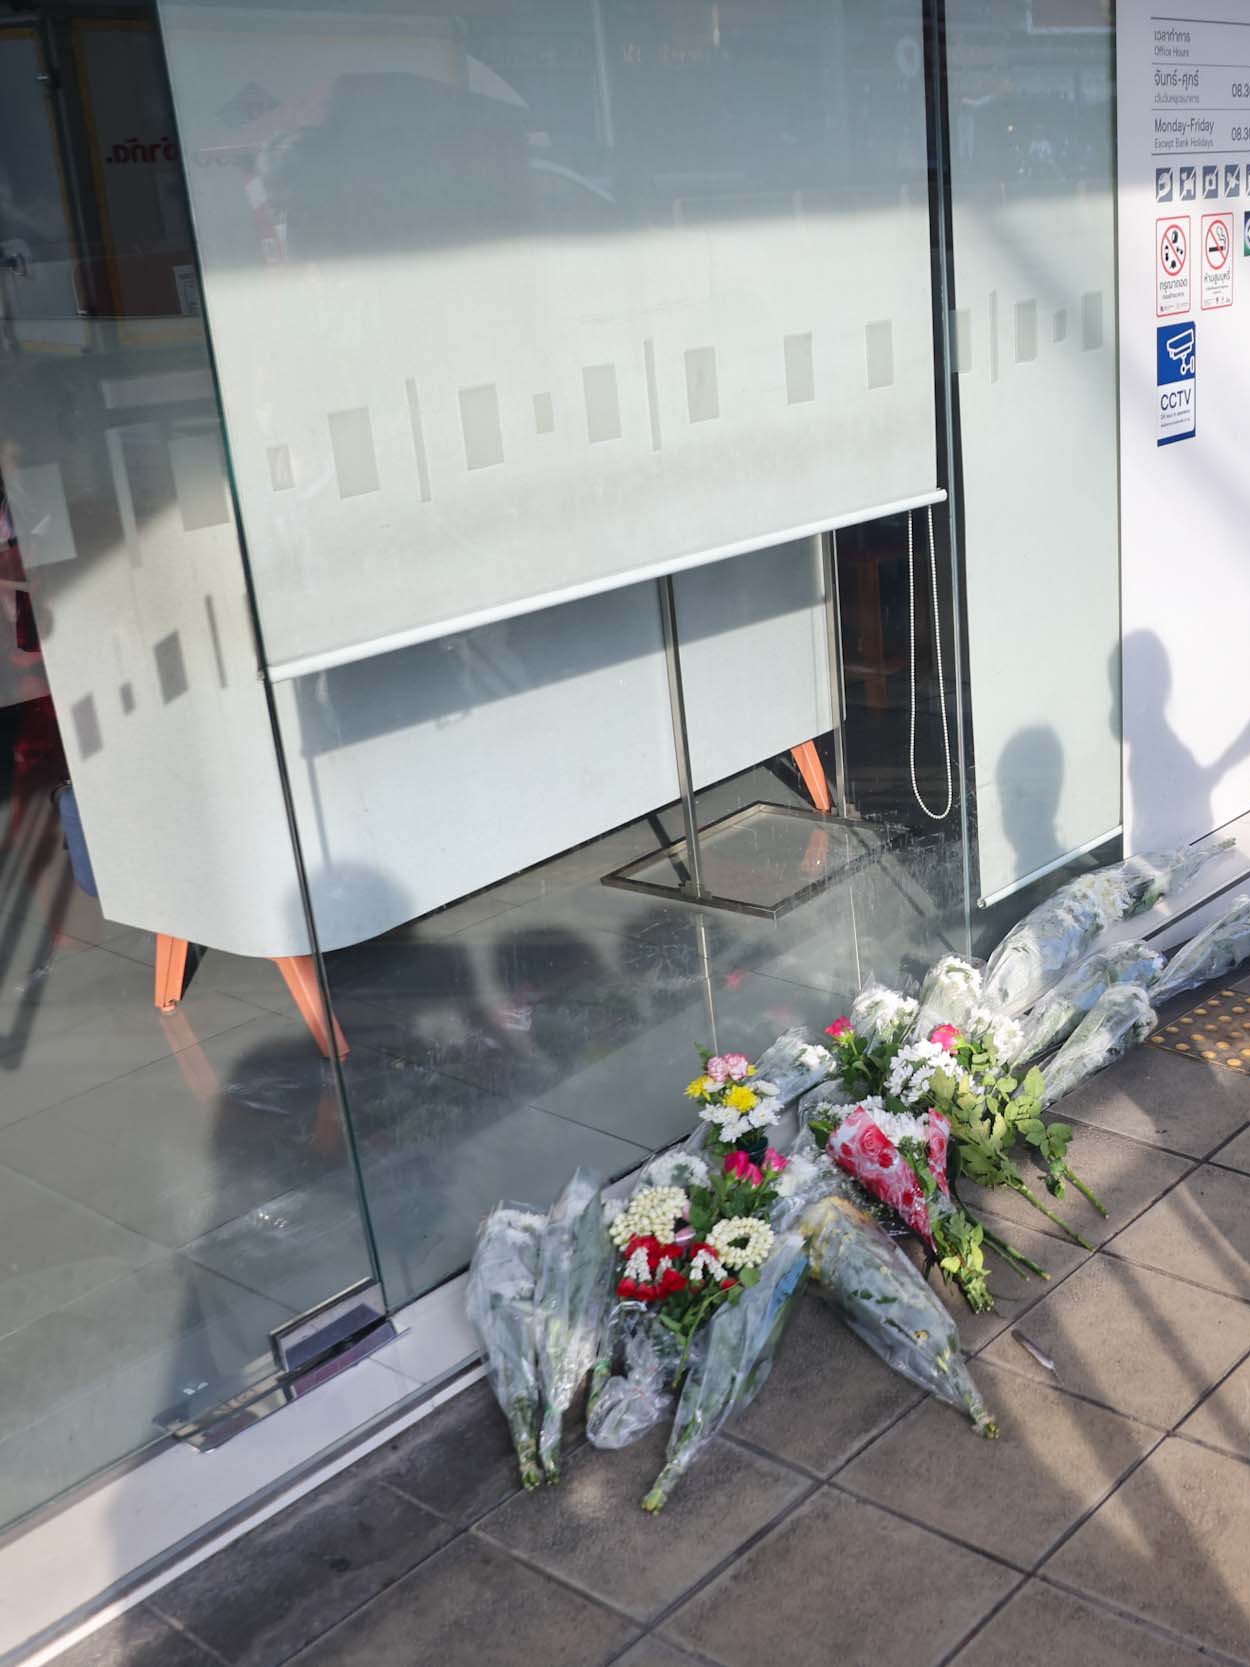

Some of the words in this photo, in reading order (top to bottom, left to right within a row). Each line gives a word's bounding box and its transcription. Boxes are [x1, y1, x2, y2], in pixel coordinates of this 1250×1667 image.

[1154, 69, 1199, 91] จันทร์-ศุกร์
[1154, 117, 1214, 135] Monday-Friday
[1154, 137, 1174, 149] Except
[1175, 137, 1189, 148] Bank
[1190, 136, 1214, 149] Holidays
[1160, 388, 1191, 411] CCTV
